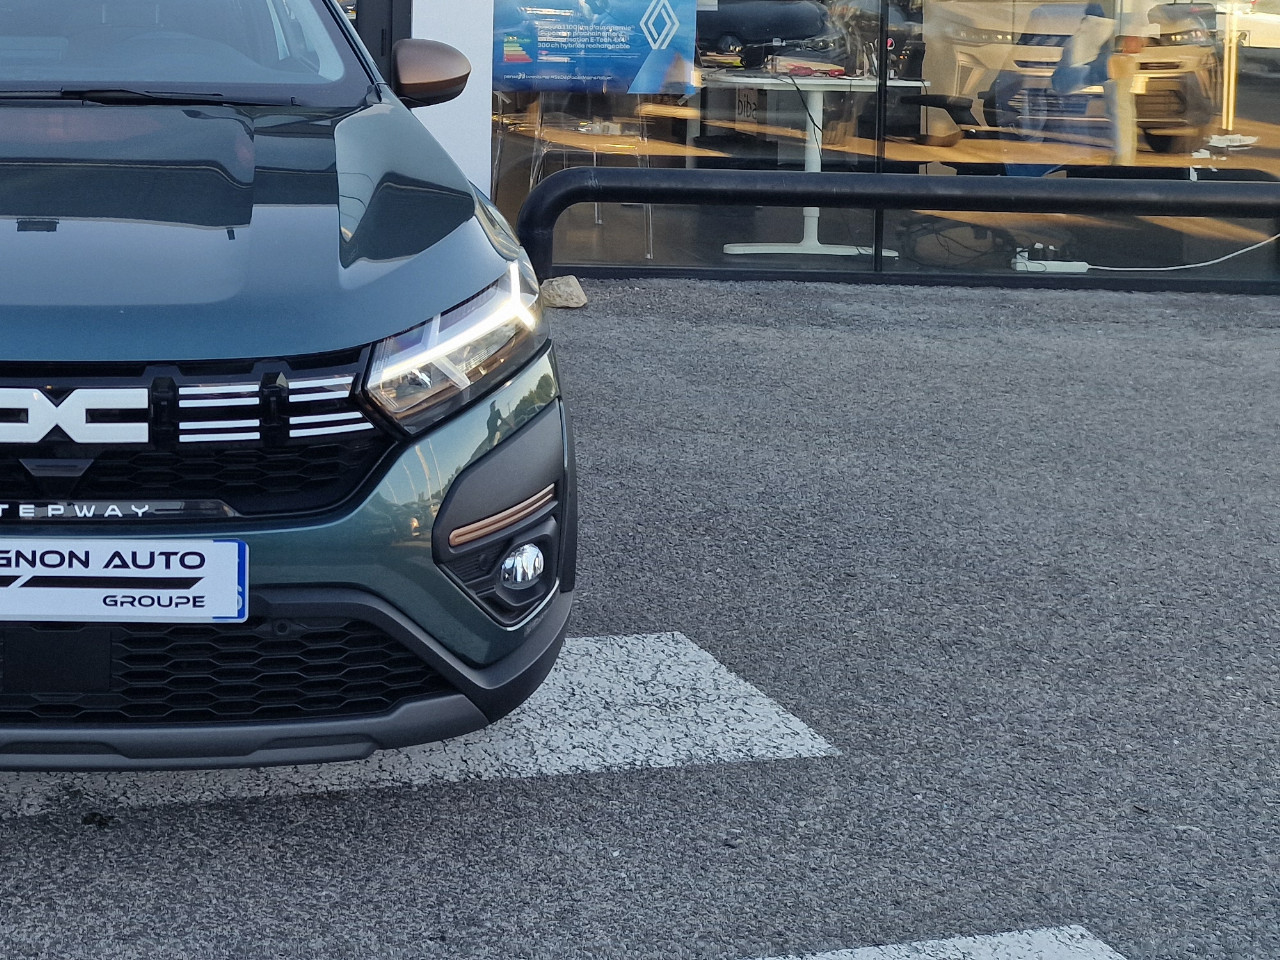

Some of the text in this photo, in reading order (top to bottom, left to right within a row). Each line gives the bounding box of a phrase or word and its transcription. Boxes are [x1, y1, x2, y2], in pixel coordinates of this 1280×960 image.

[560, 42, 585, 50] hybride
[586, 42, 631, 51] rechargeable
[102, 550, 207, 570] AUTO
[102, 595, 207, 609] GROUPE
